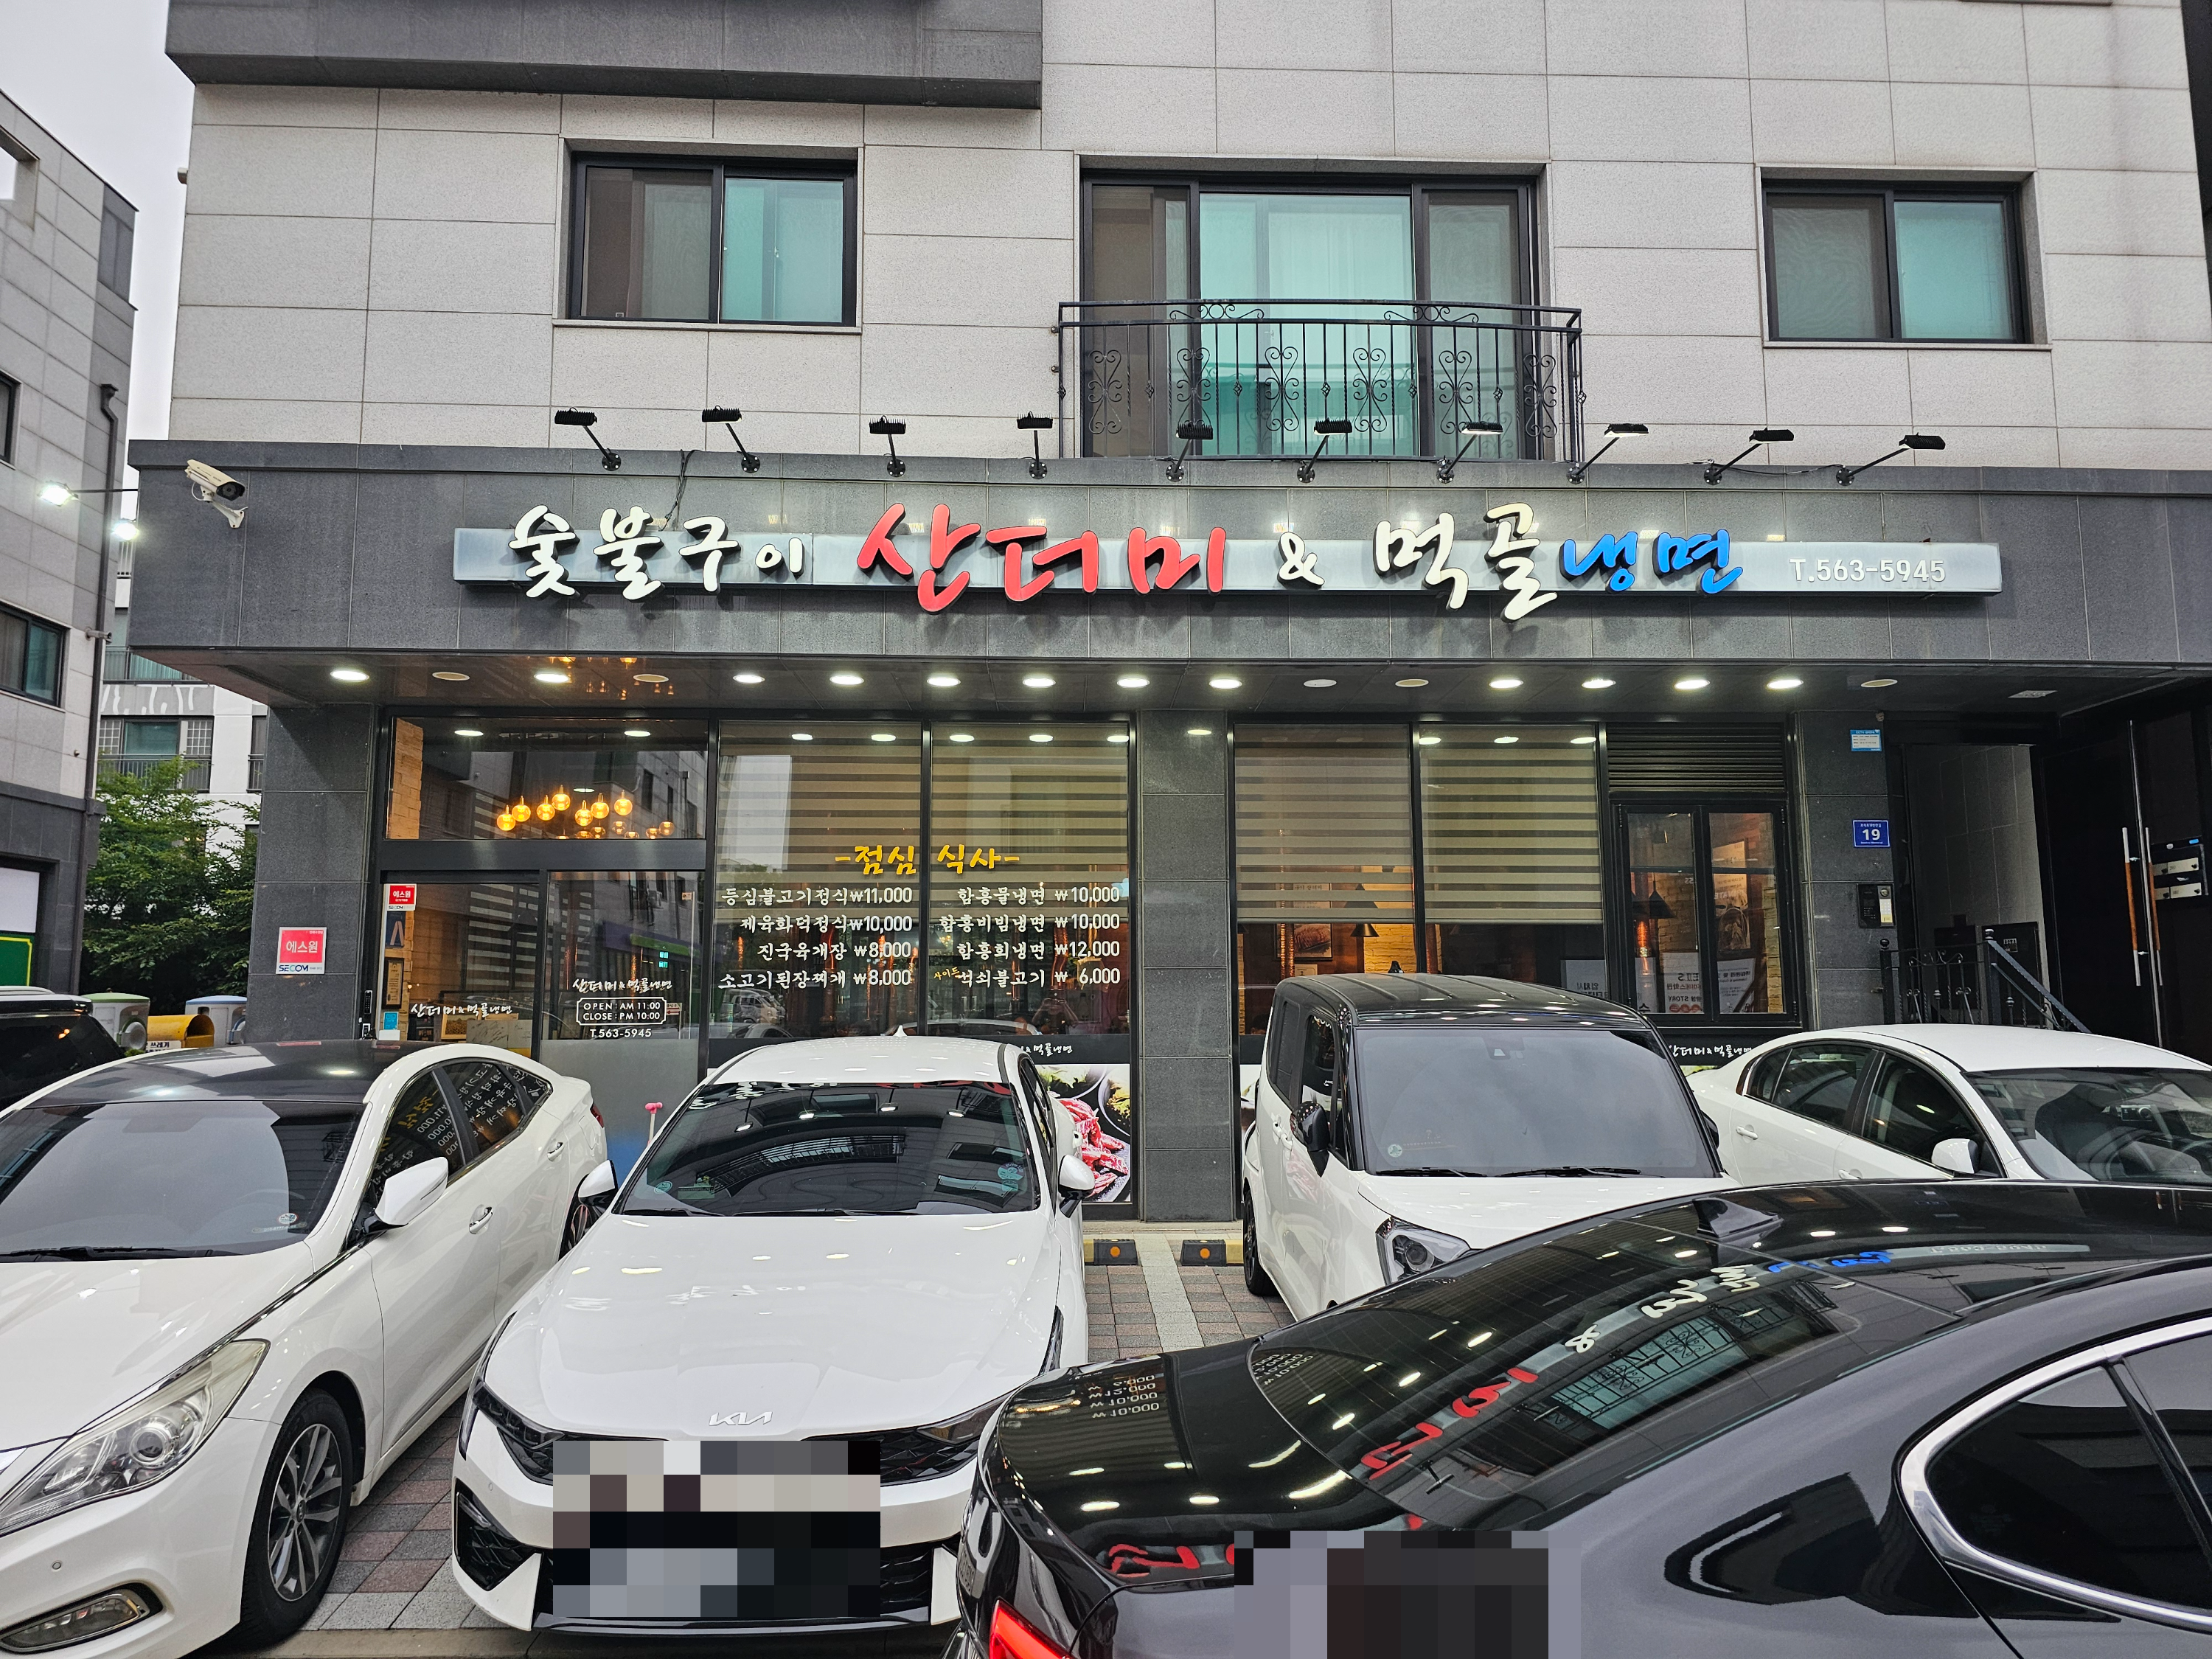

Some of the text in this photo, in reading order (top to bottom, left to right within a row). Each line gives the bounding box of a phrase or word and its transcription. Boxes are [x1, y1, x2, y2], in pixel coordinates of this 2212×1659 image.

[508, 504, 803, 601] 숯불구이
[857, 503, 1226, 614] 산더미
[1278, 531, 1325, 587] &
[1790, 557, 1947, 584] T.563-5945
[1862, 828, 1881, 841] 19
[393, 890, 411, 899] 에스원
[957, 886, 1046, 905] 함흥물냉면
[740, 914, 848, 933] 제육화덕정식
[939, 914, 1046, 933] 함흥비빔냉면
[285, 940, 319, 953] 에스원
[757, 942, 848, 961] 진국육개장
[956, 941, 1046, 961] 함흥회냉면
[279, 964, 309, 973] SECOM
[717, 970, 846, 990] 소고기된장찌개
[583, 1002, 613, 1010] OPEN
[619, 1002, 634, 1010] AM
[582, 1012, 613, 1020] CLOSE
[637, 1012, 660, 1020] 10:00
[590, 1029, 652, 1038] T.563-5945
[709, 1411, 773, 1426] KIA
